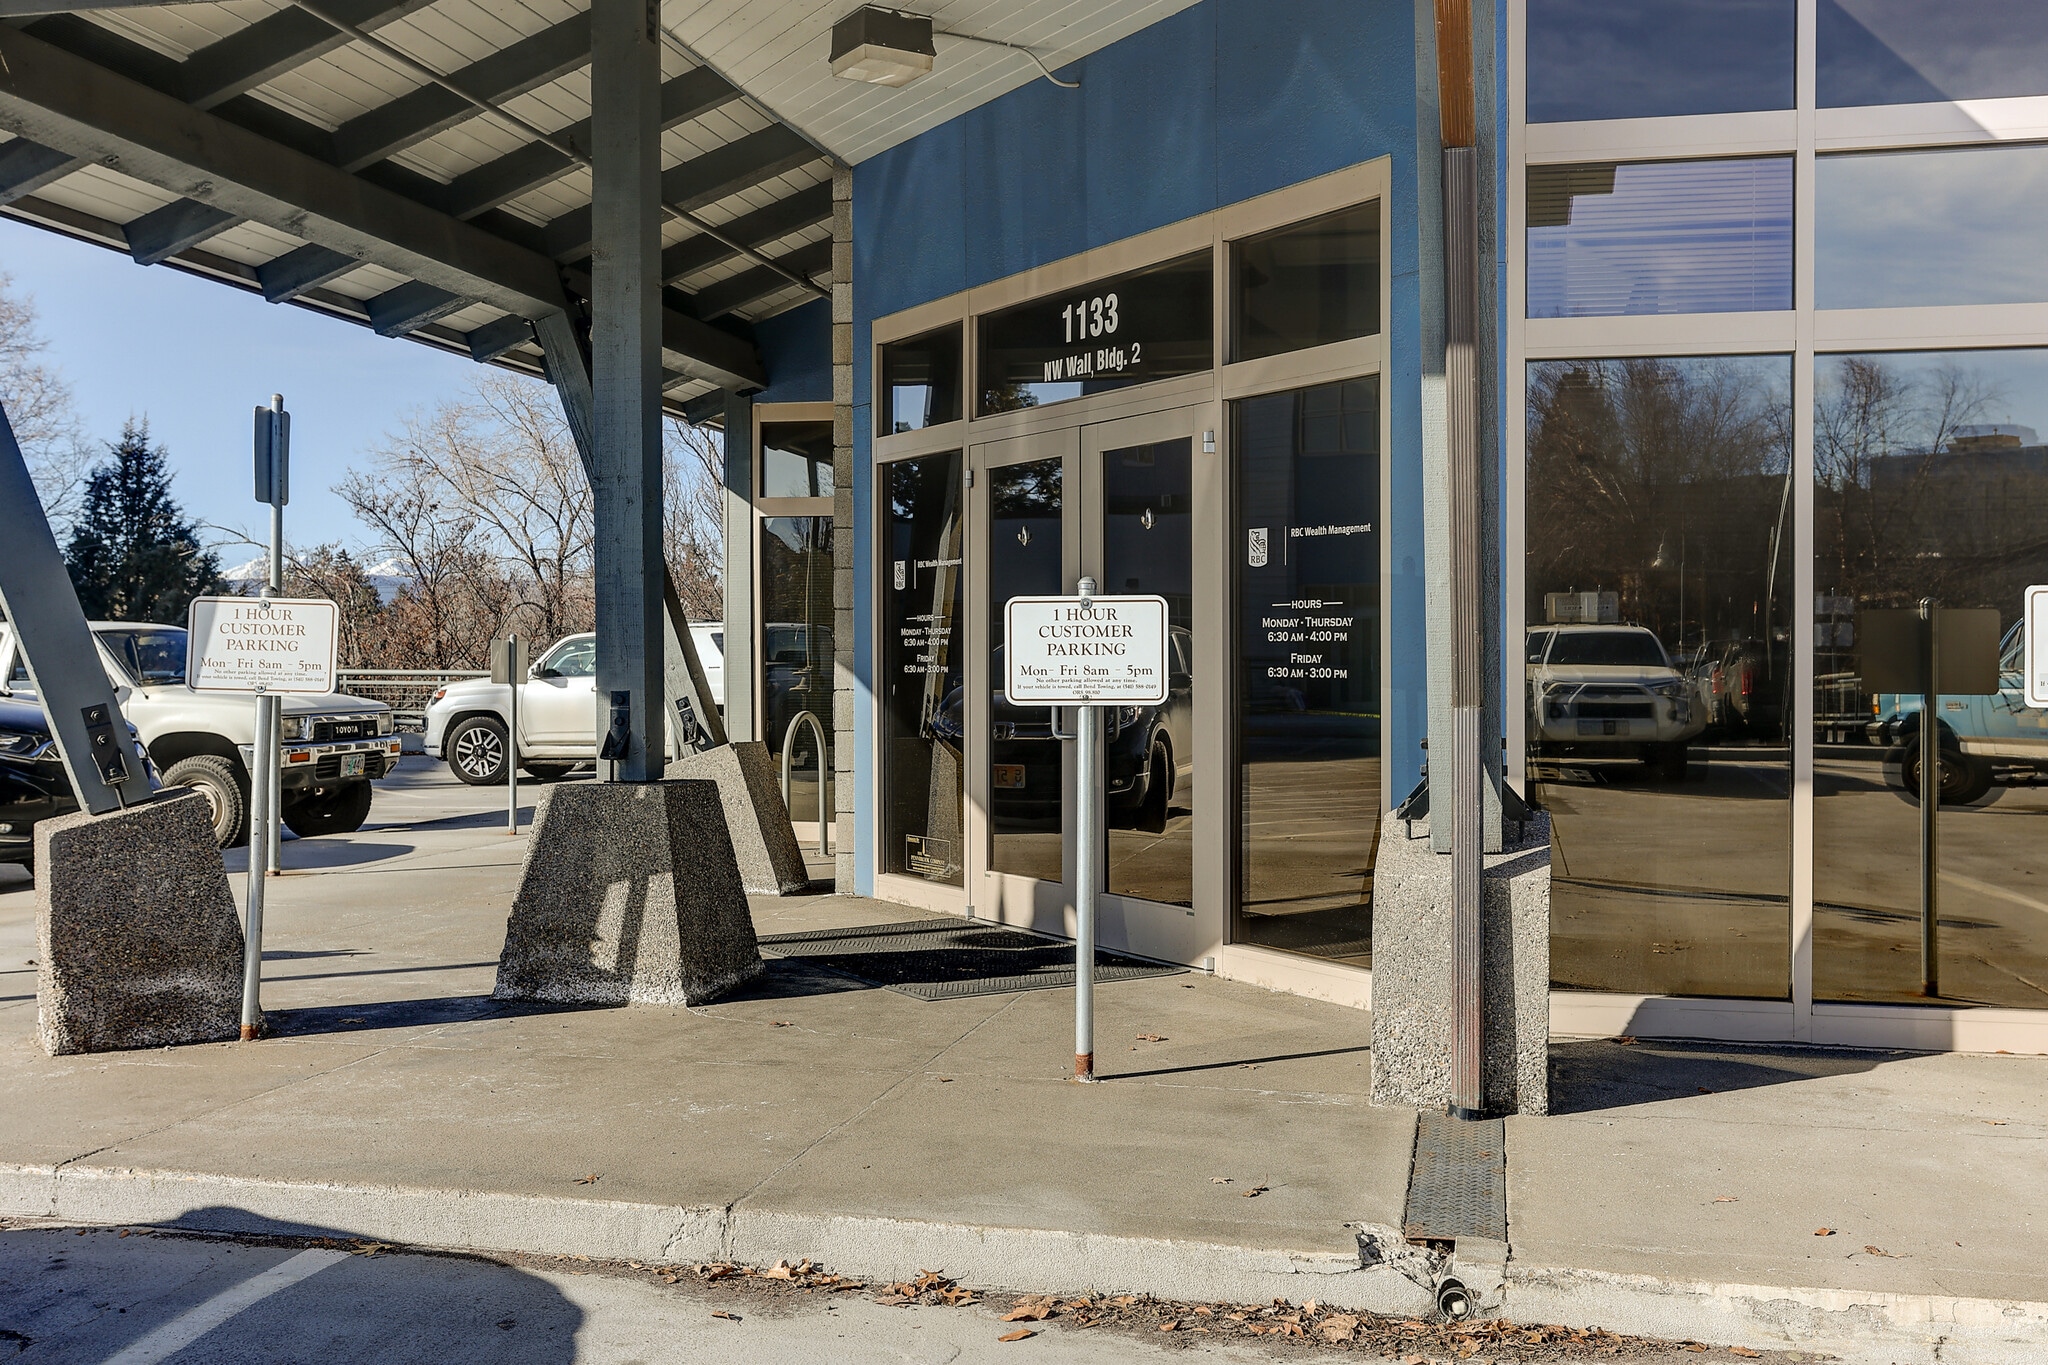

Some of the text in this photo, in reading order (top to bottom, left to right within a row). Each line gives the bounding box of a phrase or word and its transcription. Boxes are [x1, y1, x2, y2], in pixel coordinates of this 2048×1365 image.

[1062, 293, 1119, 343] 1133
[1044, 342, 1141, 382] NW Wall, Bldg. 2
[1291, 522, 1371, 538] RBC Wealth Management
[1250, 555, 1266, 564] RBC
[1291, 600, 1322, 609] HOURS
[234, 608, 293, 621] 1 HOUR
[1054, 608, 1118, 621] 1 HOUR
[220, 623, 306, 636] CUSTOMER
[1039, 625, 1133, 638] CUSTOMER
[1267, 631, 1289, 642] 6:30
[1290, 632, 1304, 641] AM
[1309, 631, 1332, 641] 4:00
[1334, 632, 1348, 641] PM
[226, 639, 299, 652] PARKING
[1047, 643, 1126, 656] PARKING
[237, 658, 253, 668] Fri
[258, 659, 282, 669] 8am
[298, 660, 322, 672] 5pm
[1060, 665, 1078, 676] Fri
[1083, 665, 1109, 676] 8am
[1127, 665, 1153, 678] 5pm
[1267, 667, 1289, 678] 6:30
[1290, 669, 1304, 678] AM
[1309, 667, 1332, 678] 3:00
[1334, 669, 1348, 679] PM
[335, 725, 359, 734] TOYOTA
